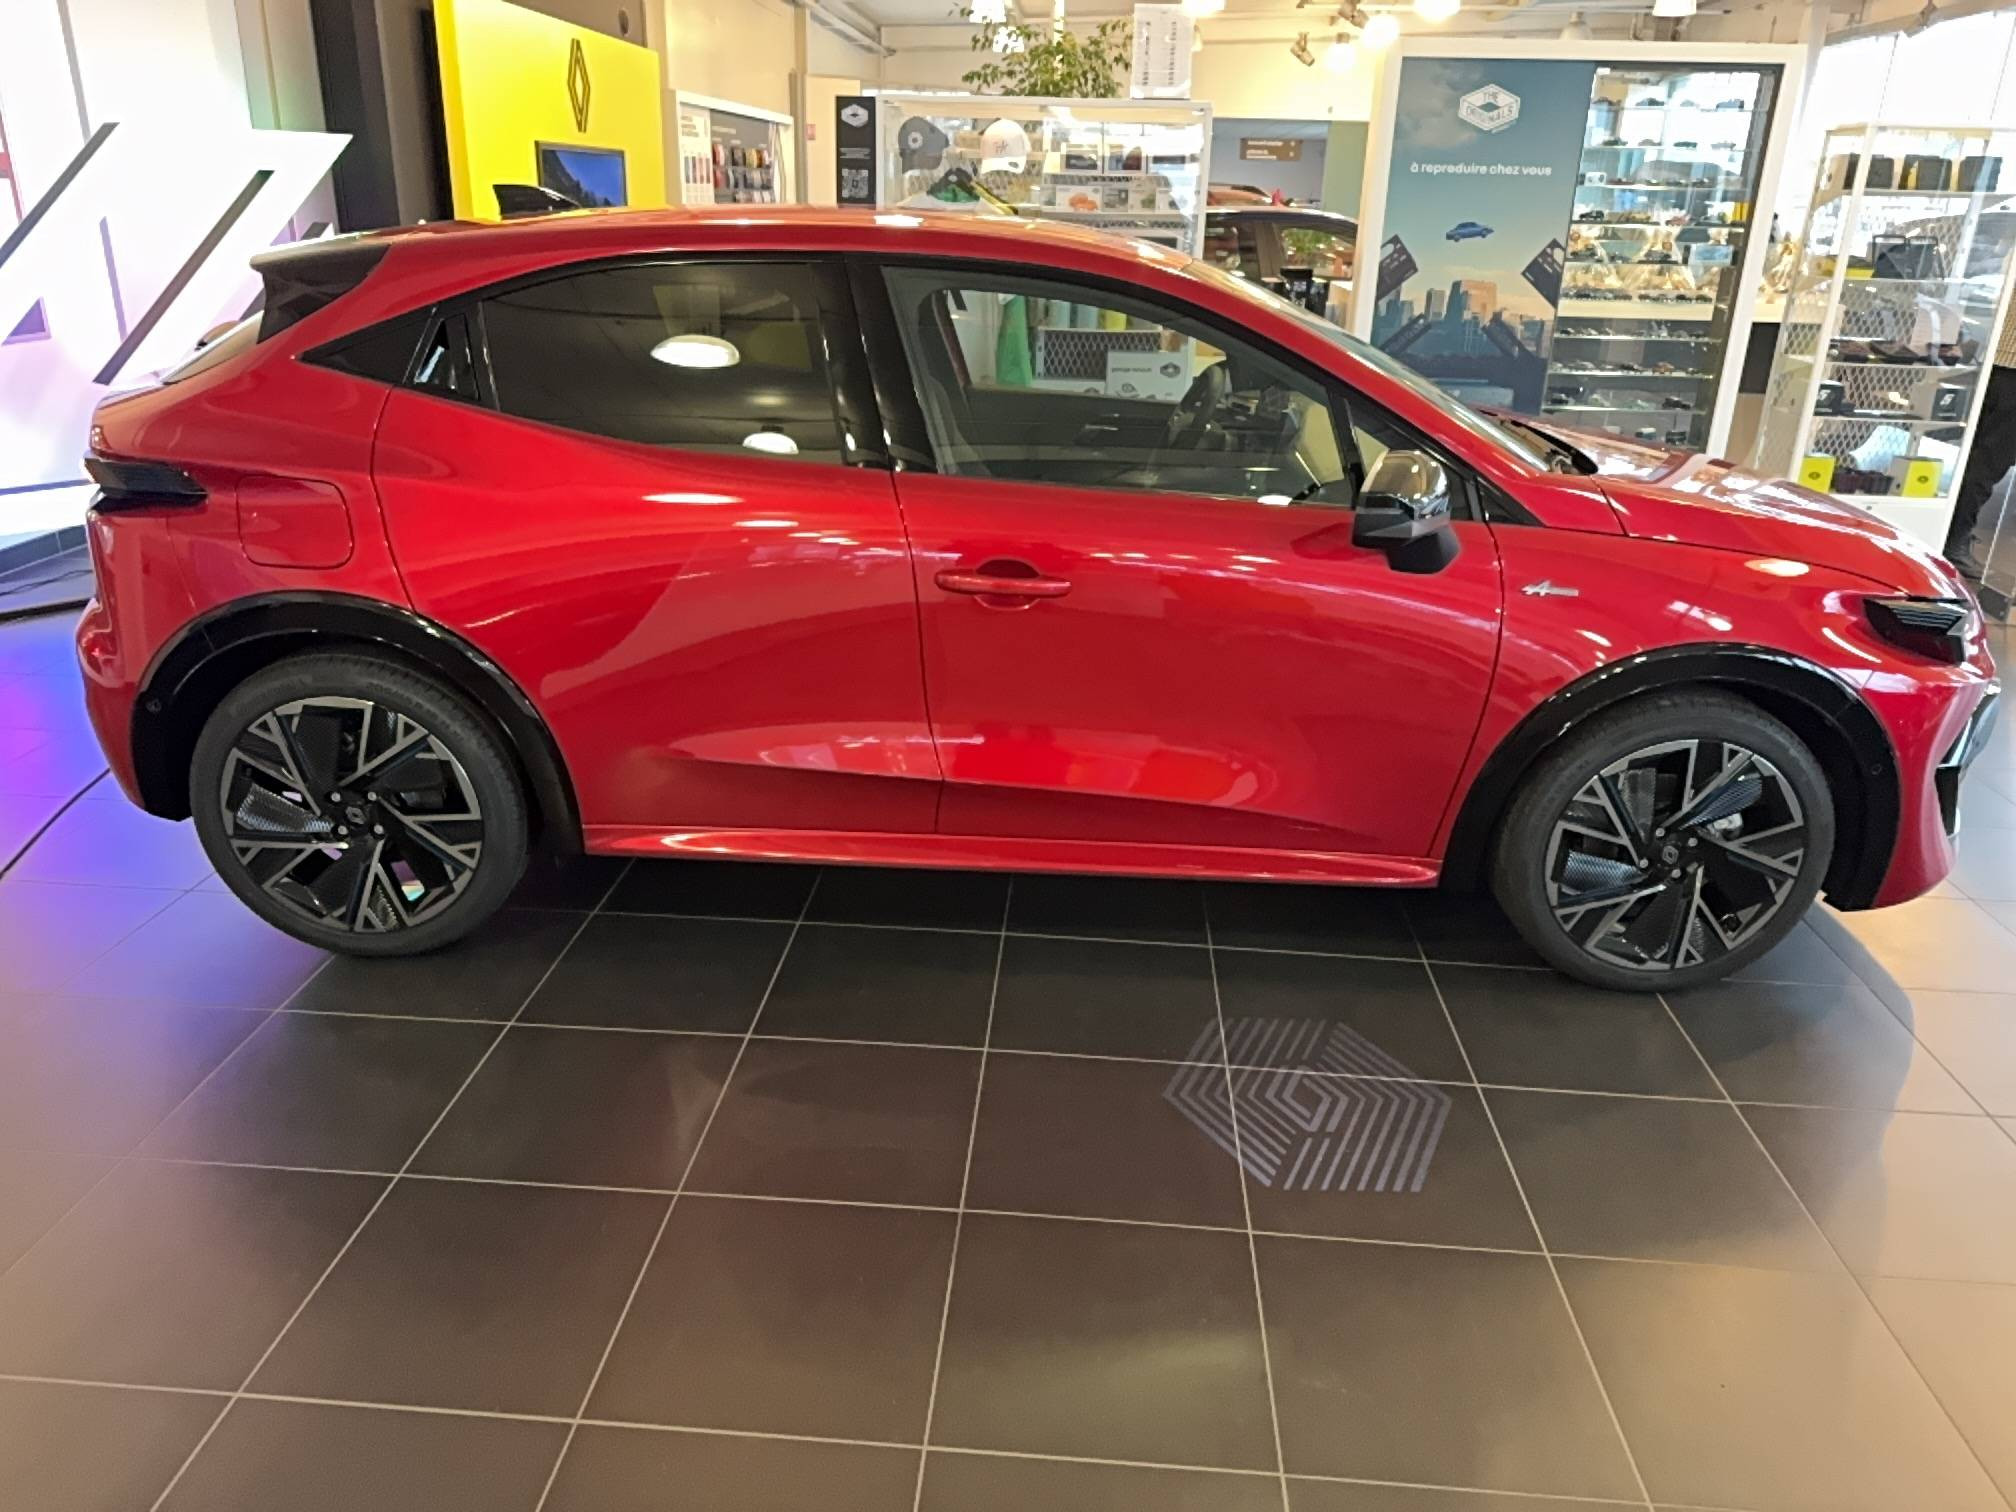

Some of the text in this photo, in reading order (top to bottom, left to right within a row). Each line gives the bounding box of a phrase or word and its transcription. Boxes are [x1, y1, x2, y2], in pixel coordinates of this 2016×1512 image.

[1410, 162, 1552, 176] à reproduire chez vous
